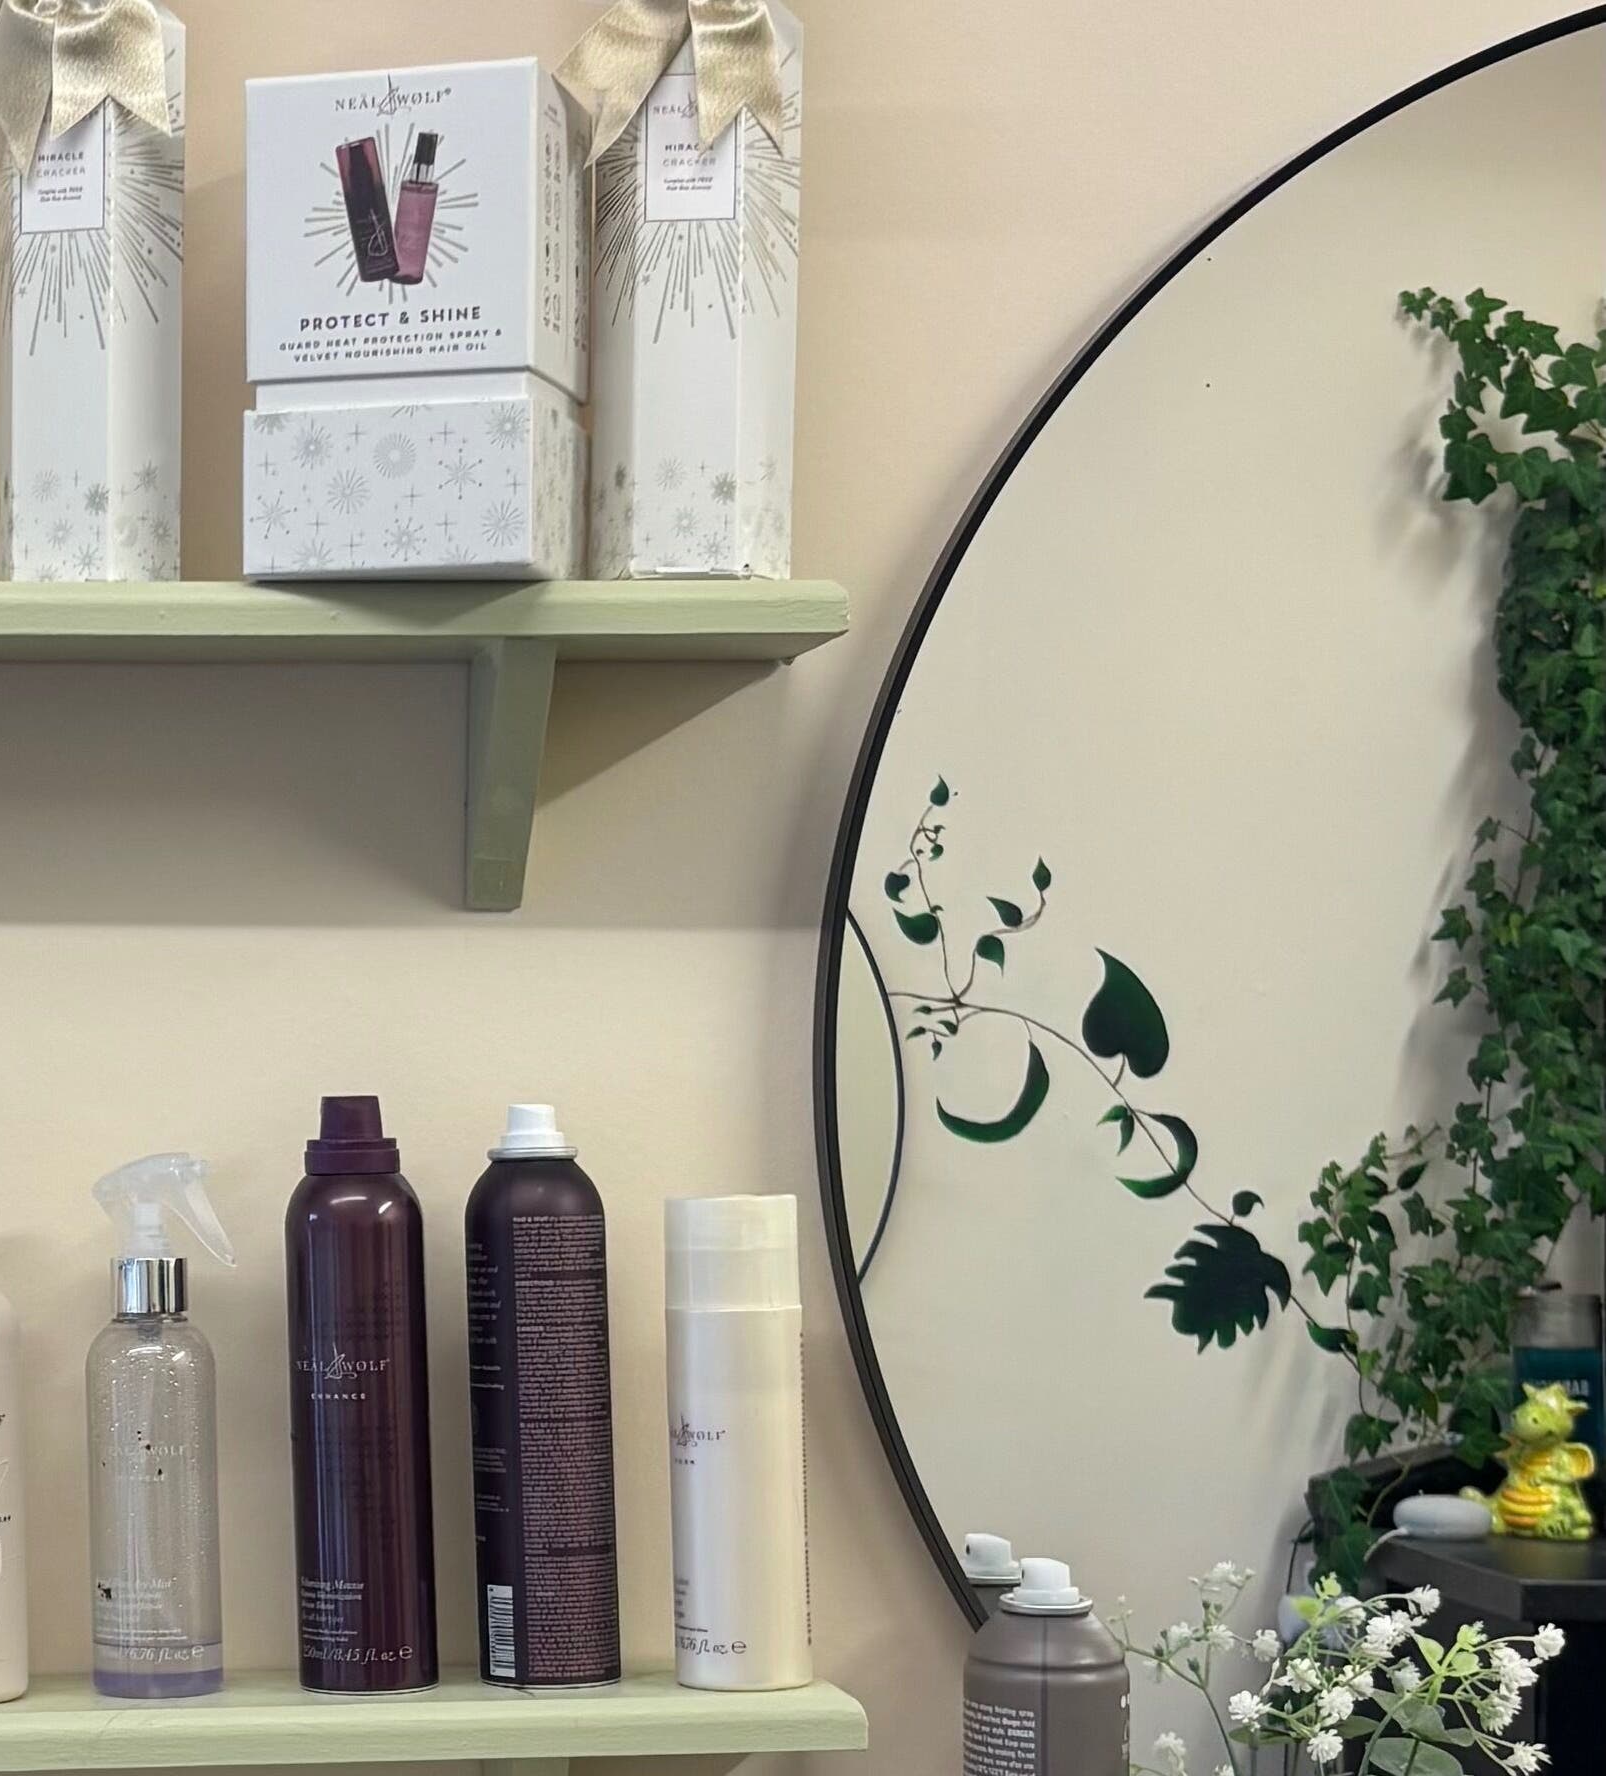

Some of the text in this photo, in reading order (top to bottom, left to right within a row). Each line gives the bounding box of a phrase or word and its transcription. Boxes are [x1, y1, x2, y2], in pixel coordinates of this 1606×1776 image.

[299, 306, 482, 332] PROTECT & SHINE
[279, 340, 321, 351] GUARD
[326, 337, 358, 348] HEAT
[363, 332, 443, 346] PROTECTION
[448, 329, 489, 340] SPRAY
[294, 342, 487, 363] VELVET NOURISHING HAIR OIL
